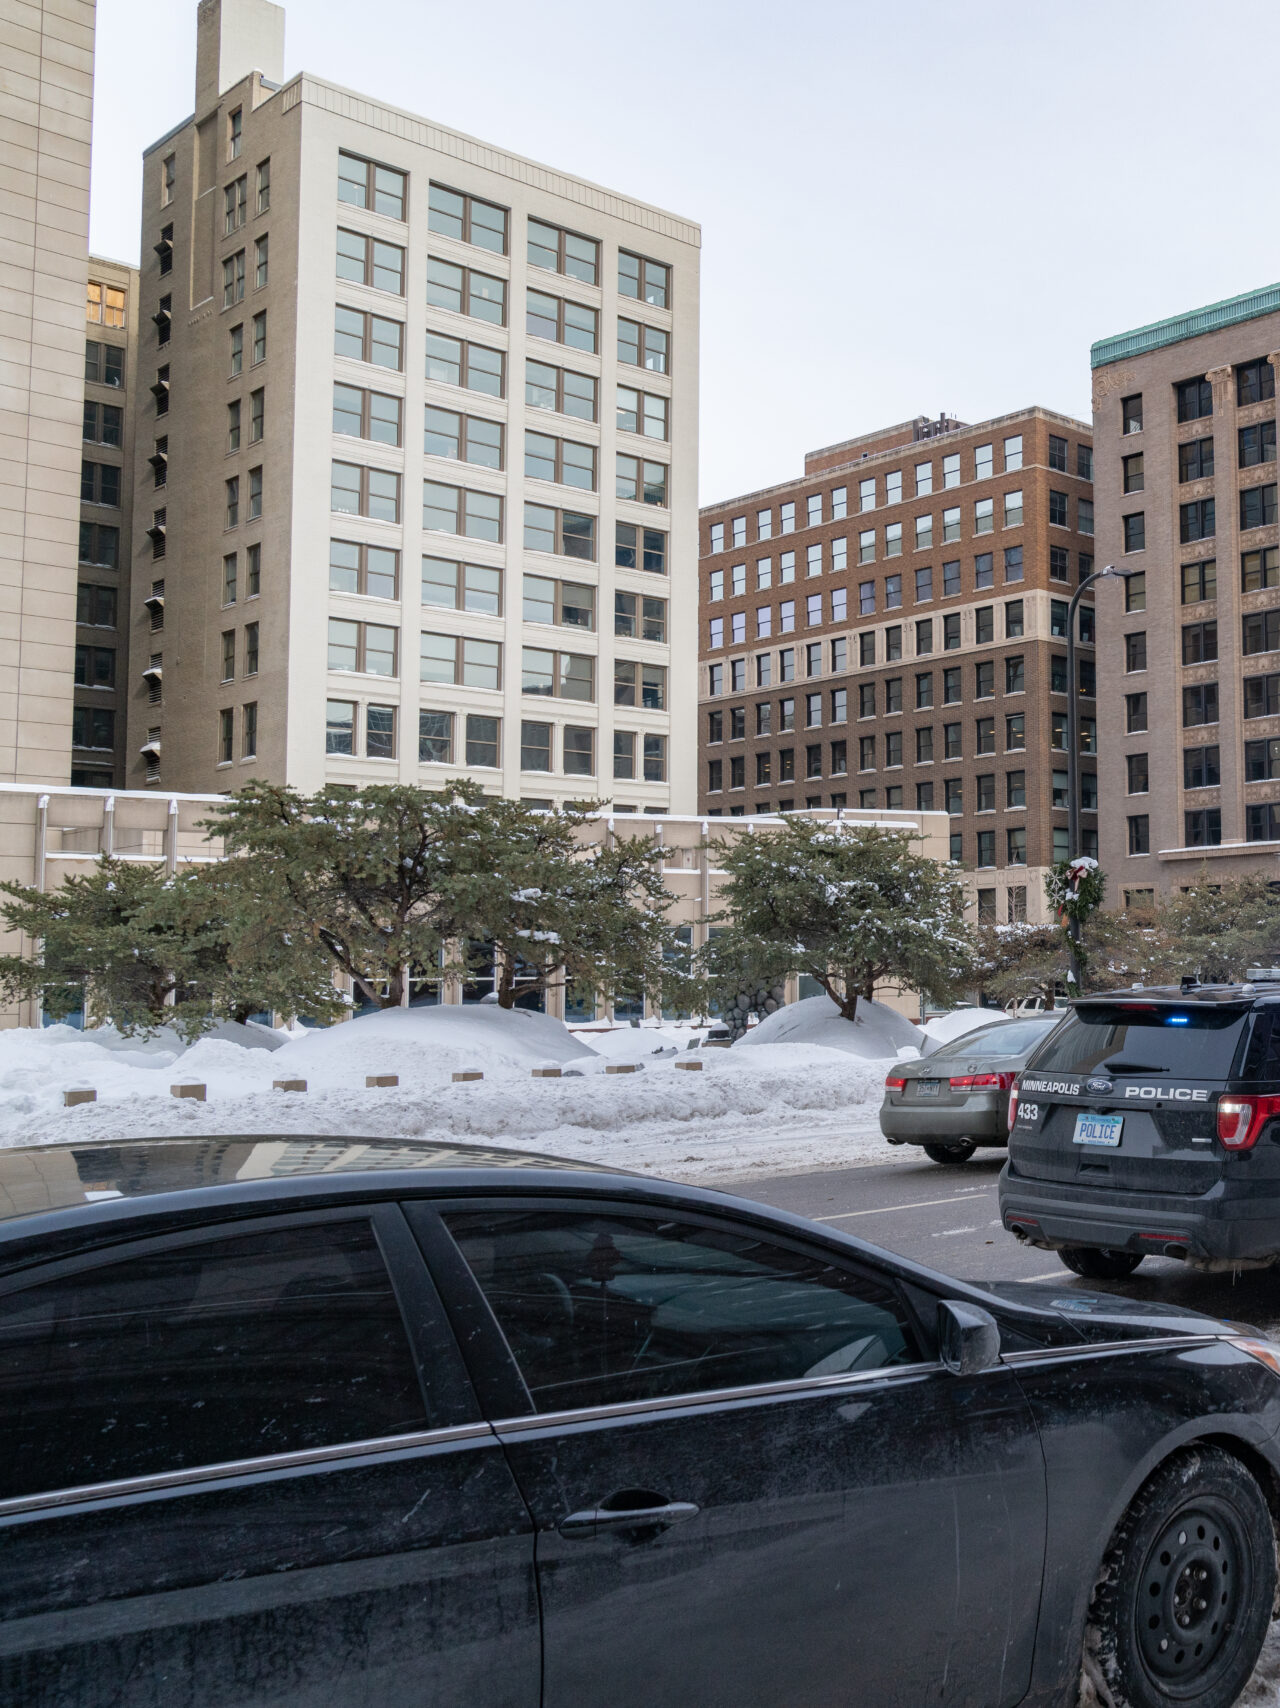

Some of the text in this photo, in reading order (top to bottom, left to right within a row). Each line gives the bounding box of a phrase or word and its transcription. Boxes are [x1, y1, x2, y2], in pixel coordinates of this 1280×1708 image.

[1022, 1080, 1208, 1101] MINNEAPOLIS Ford POLICE
[1017, 1103, 1039, 1120] 433
[1080, 1123, 1117, 1139] POLICE
